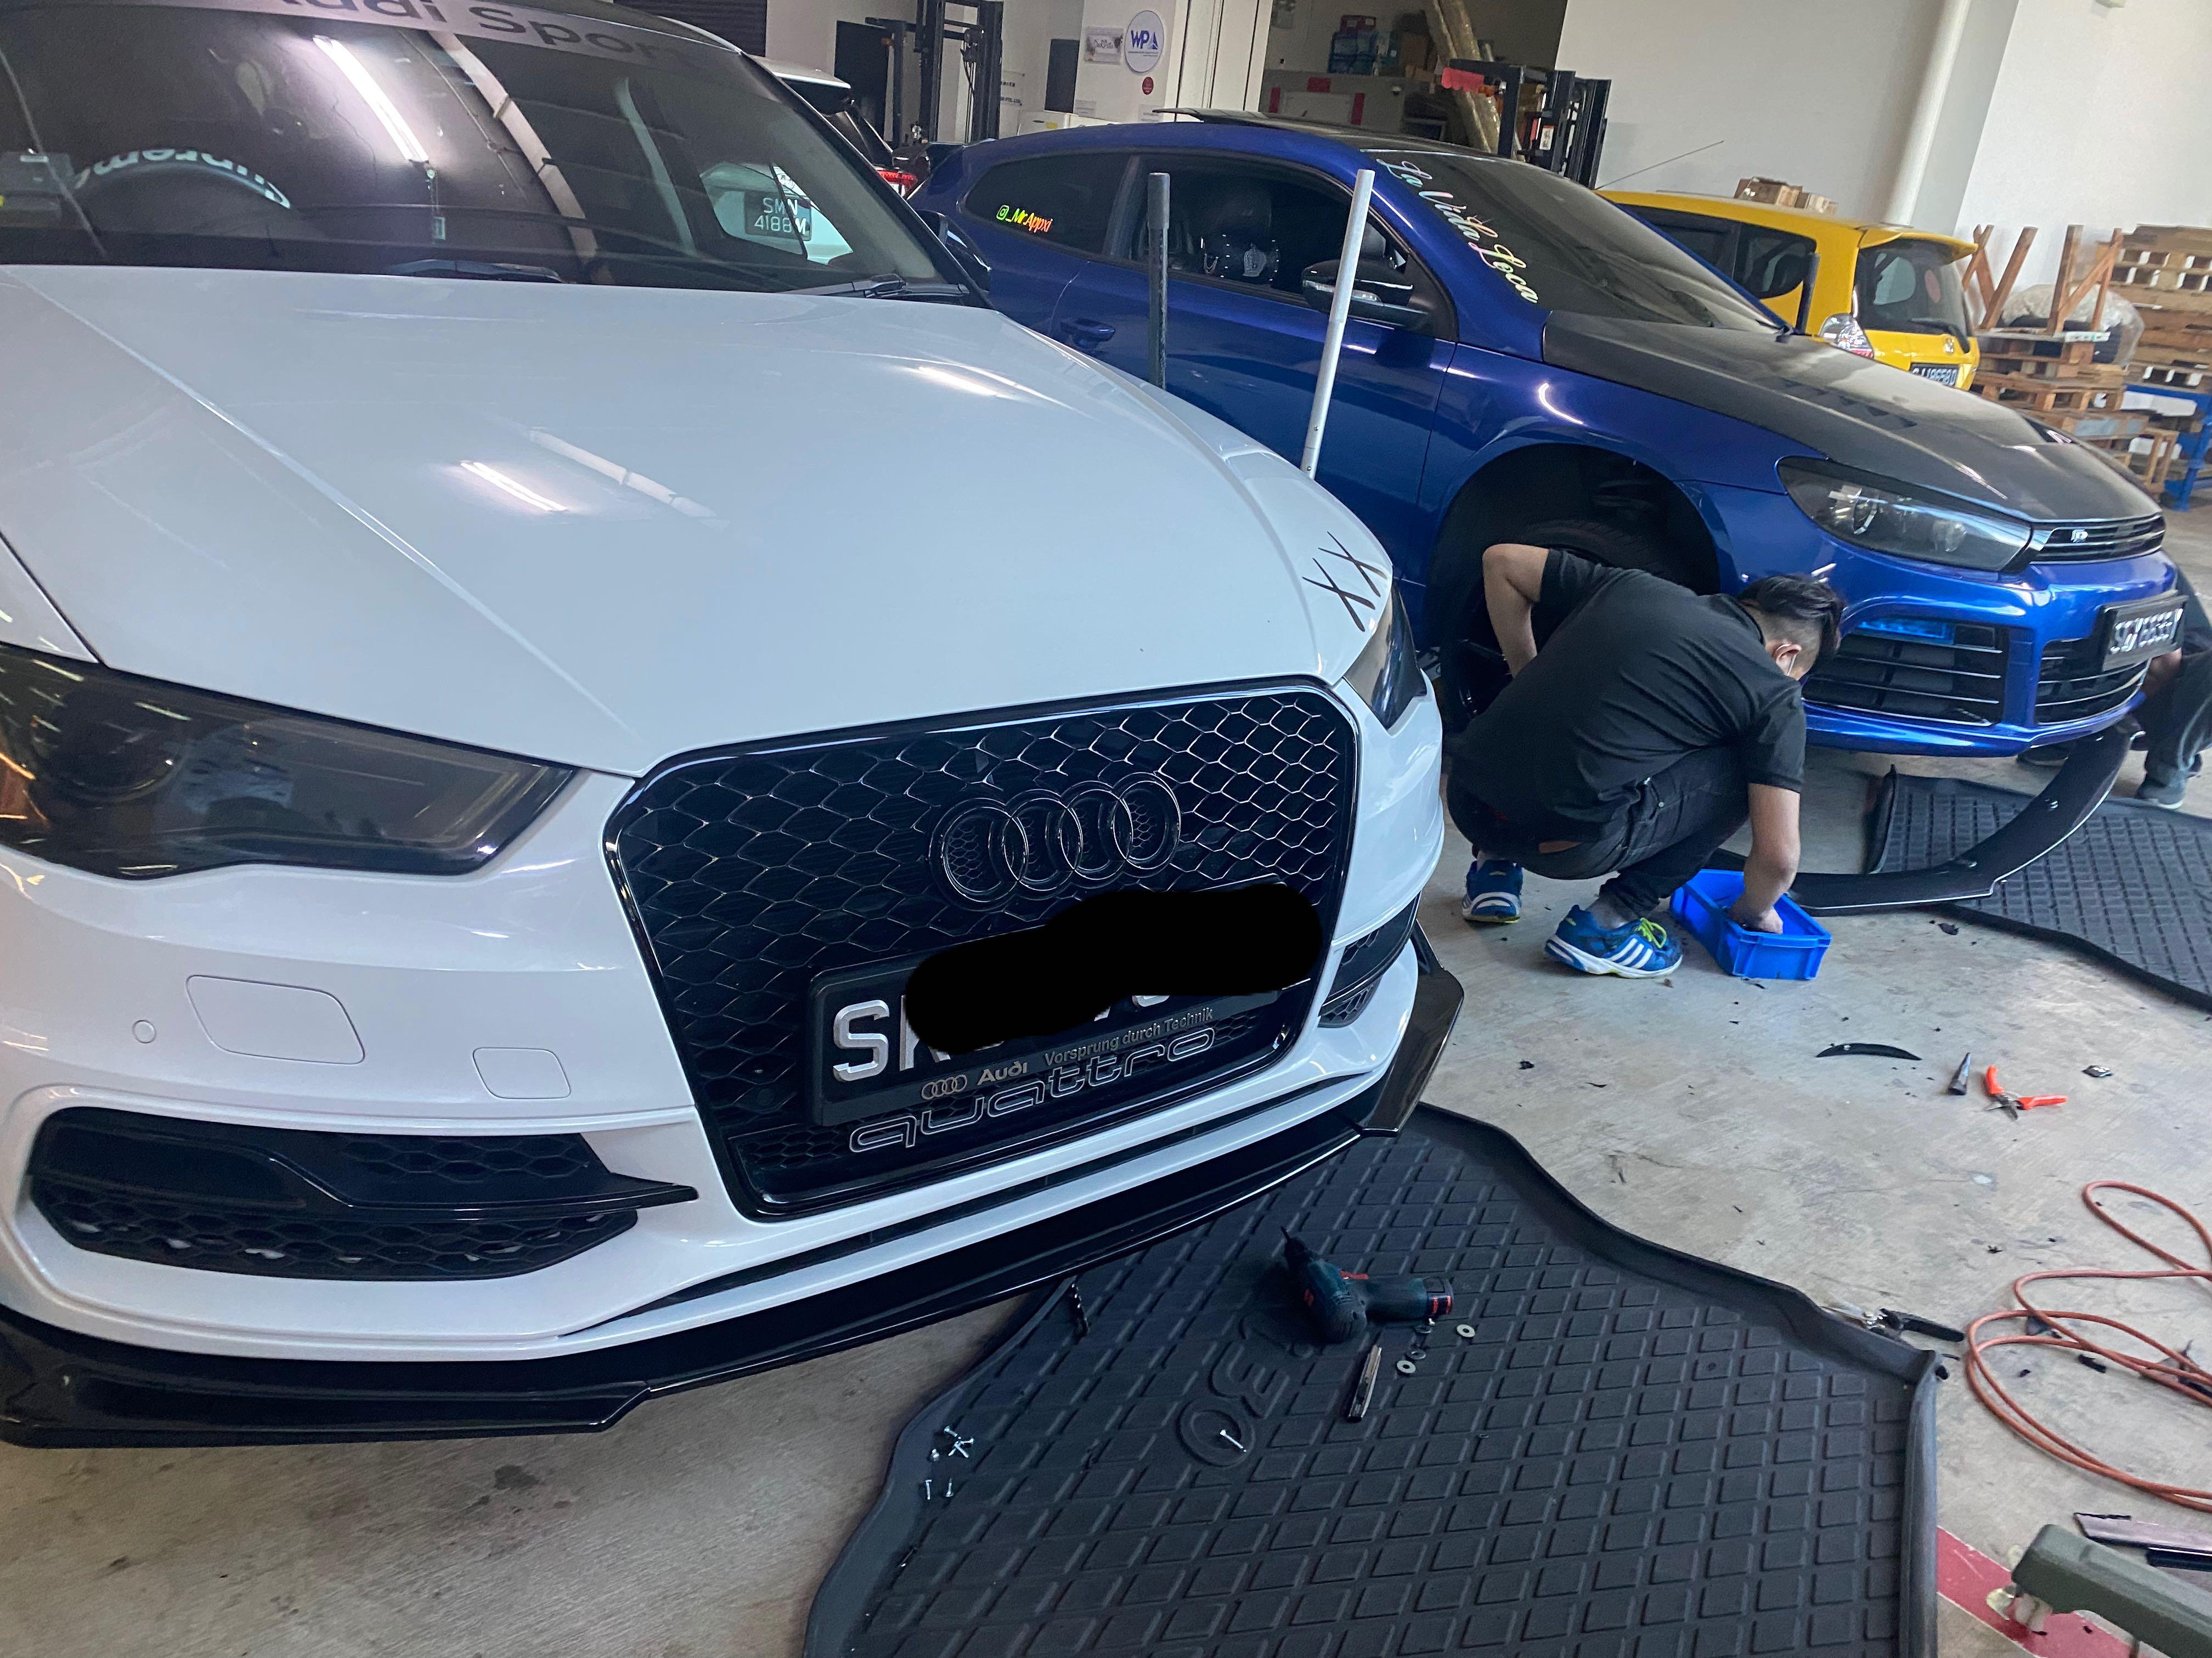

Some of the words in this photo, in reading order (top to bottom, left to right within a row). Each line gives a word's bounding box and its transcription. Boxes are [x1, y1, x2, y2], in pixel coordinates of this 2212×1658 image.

[281, 0, 447, 22] udi
[469, 6, 663, 59] Spor
[1376, 158, 1432, 188] La
[1418, 190, 1498, 241] Vida
[1468, 244, 1538, 303] Loca
[849, 1027, 1215, 1153] quattro
[977, 1061, 1028, 1086] Audi
[1045, 1038, 1119, 1067] Vorsprung
[1122, 1022, 1161, 1045] durch
[1164, 1007, 1214, 1033] Technik
